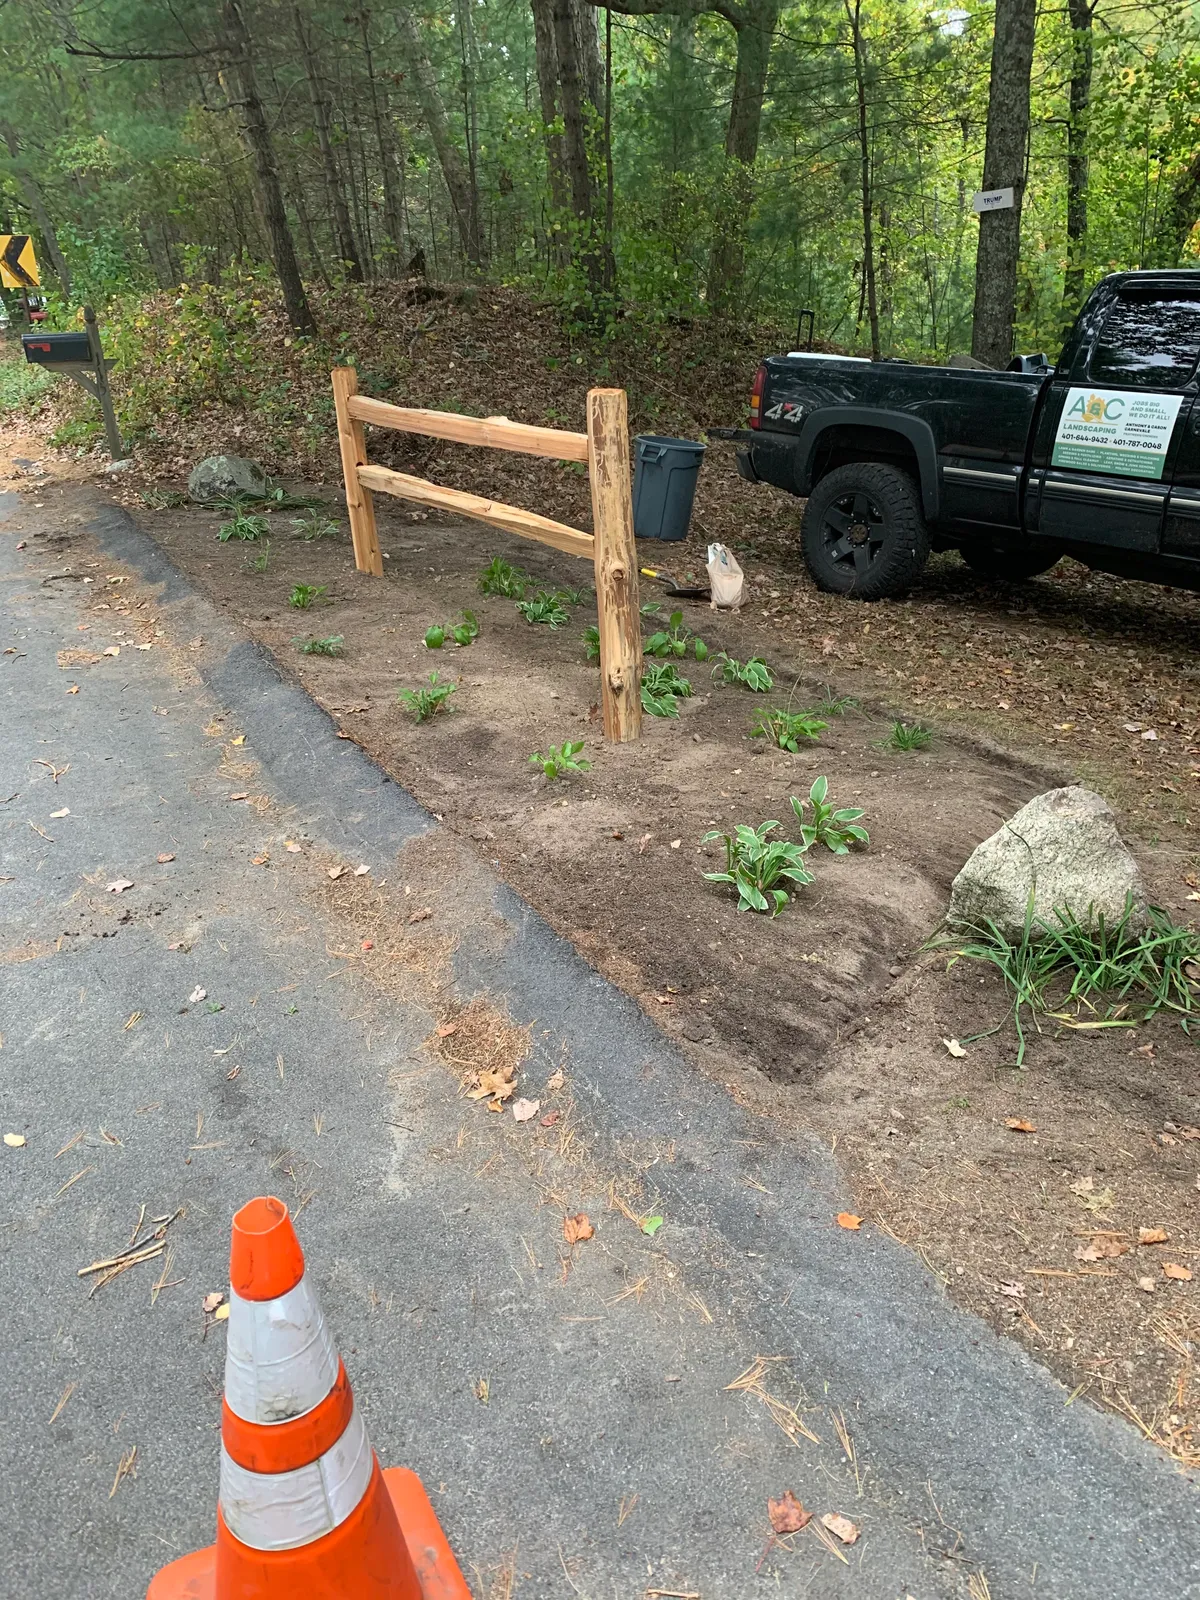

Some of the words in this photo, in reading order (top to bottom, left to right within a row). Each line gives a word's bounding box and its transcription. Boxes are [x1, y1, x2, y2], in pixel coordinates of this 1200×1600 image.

[984, 195, 1003, 204] TRUMP
[1063, 424, 1117, 434] LANDSCAPING
[1061, 433, 1109, 444] 401-644-9432
[1113, 438, 1163, 450] 401-787-0048
